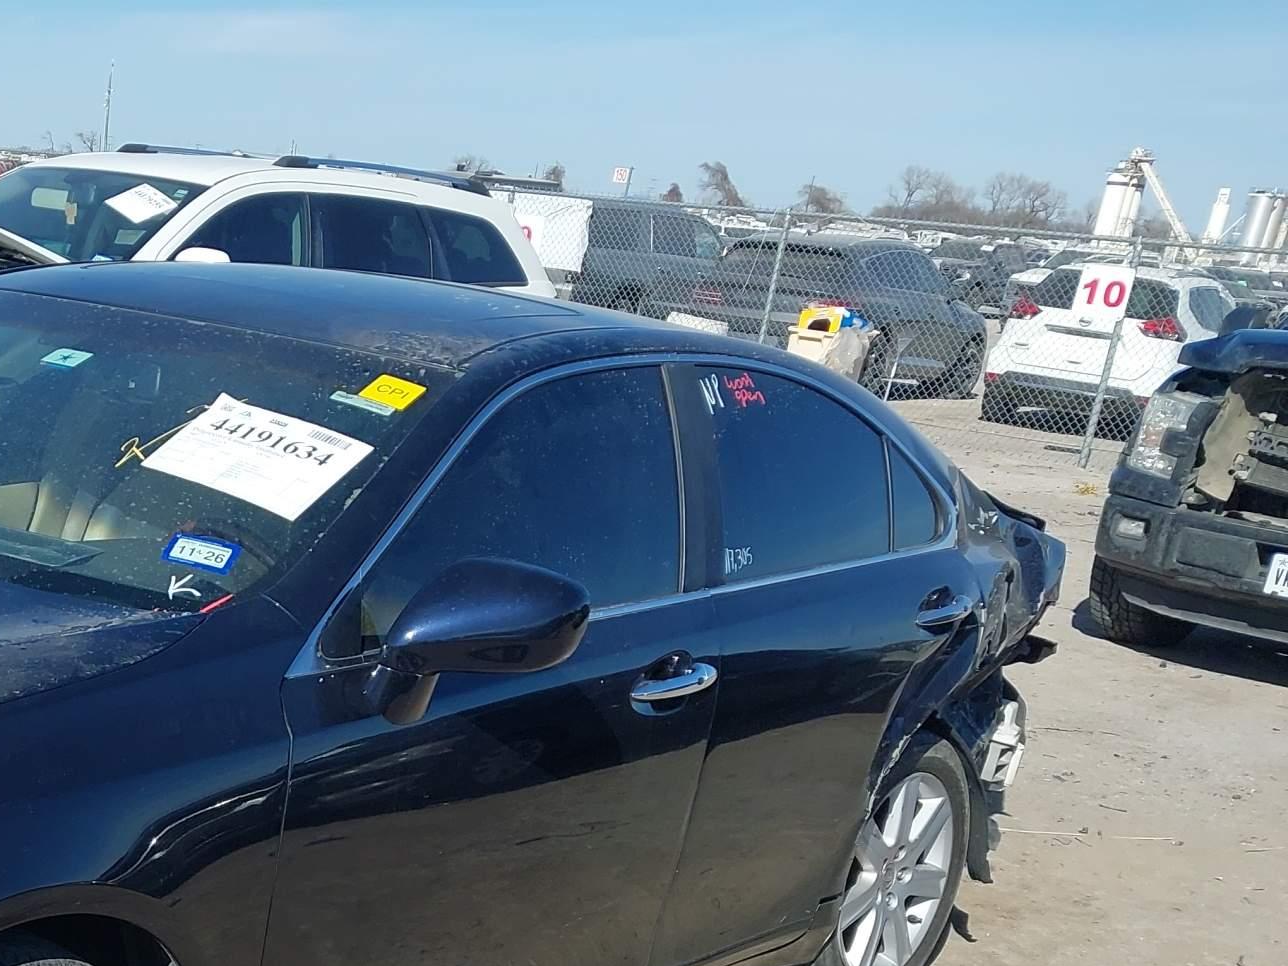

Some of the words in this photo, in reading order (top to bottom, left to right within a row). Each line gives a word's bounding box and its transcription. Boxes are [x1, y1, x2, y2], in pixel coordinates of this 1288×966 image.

[615, 169, 627, 182] 150
[1083, 278, 1127, 308] 10
[376, 383, 410, 400] CPI
[734, 389, 766, 408] open
[209, 418, 335, 467] 44191634
